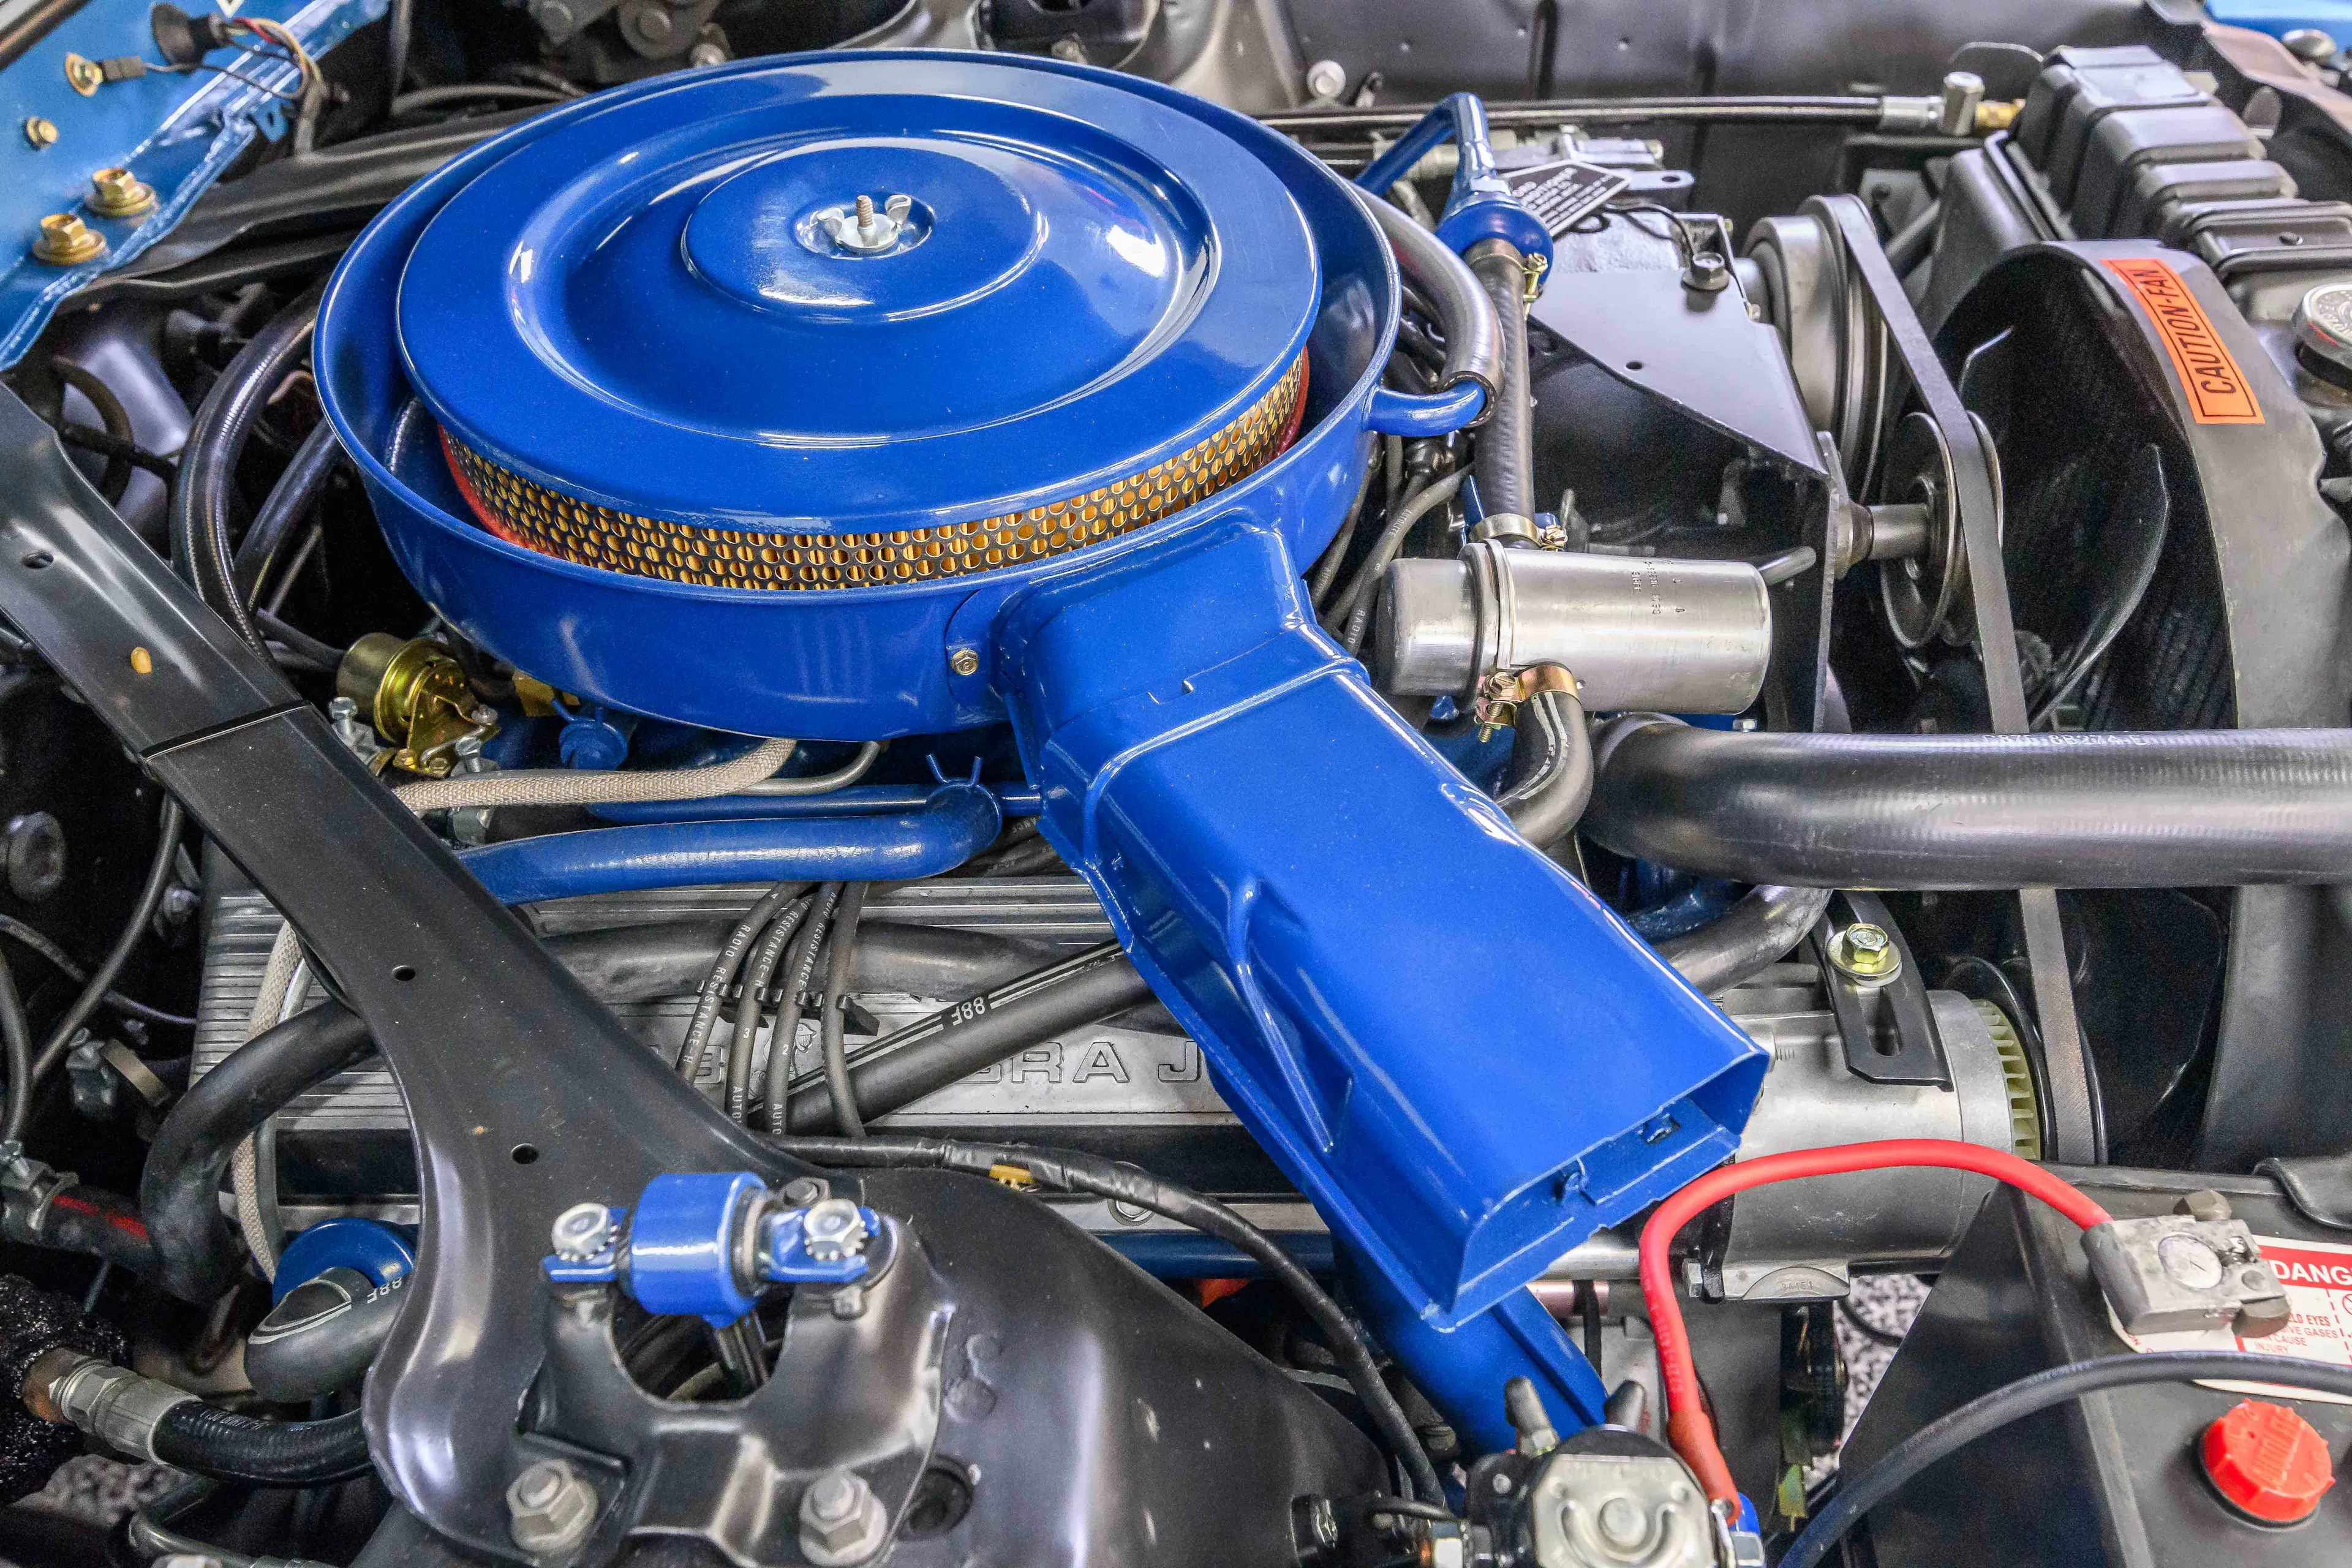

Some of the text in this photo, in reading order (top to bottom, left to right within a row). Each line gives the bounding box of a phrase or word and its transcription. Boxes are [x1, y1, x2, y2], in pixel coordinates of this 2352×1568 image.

[2128, 269, 2236, 393] CAUTION-FAN
[1347, 609, 1366, 644] RADIO
[725, 924, 752, 958] RADIO
[755, 910, 799, 987] RESISTANCE-H
[797, 922, 826, 992] RESISTANCE-
[683, 966, 727, 1064] RESISTANCE-H
[951, 996, 986, 1026] 88F
[743, 1028, 750, 1039] 3
[782, 1044, 788, 1055] 2
[731, 1086, 744, 1123] AUTO
[2269, 1259, 2352, 1286] DANG
[2304, 1327, 2339, 1339] GASES
[2306, 1315, 2331, 1327] EYES
[2275, 1333, 2308, 1346] CAUSE
